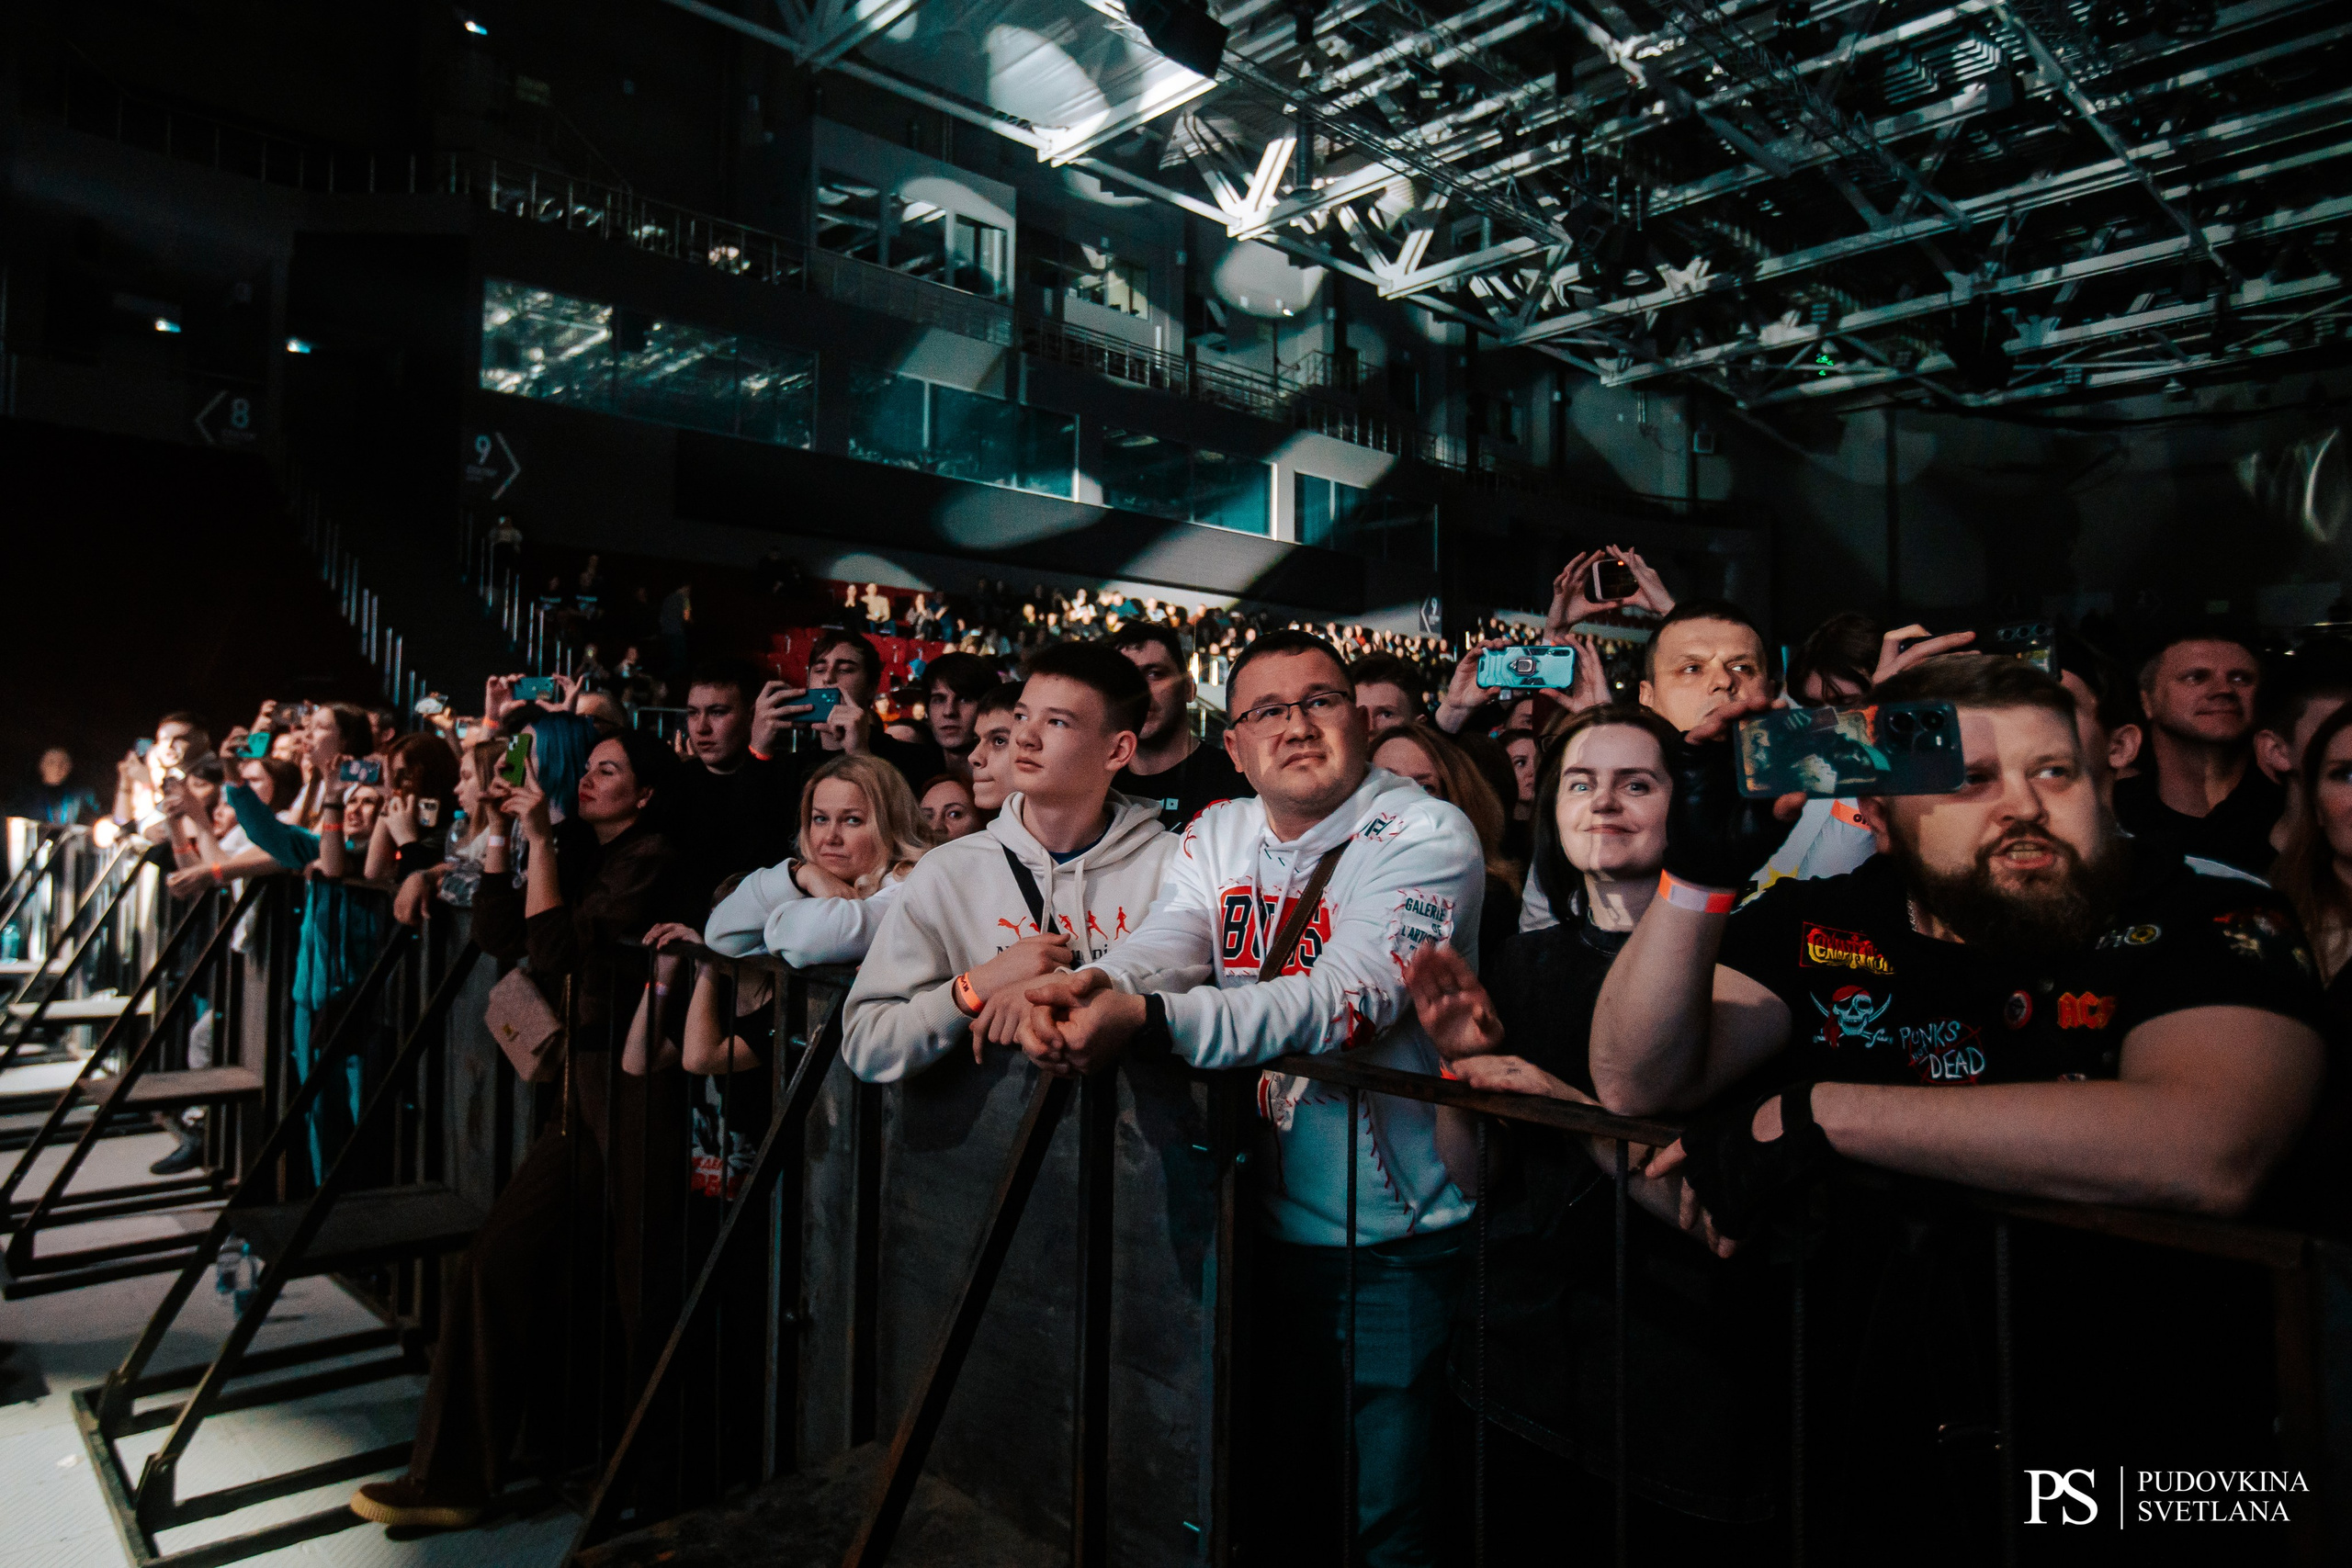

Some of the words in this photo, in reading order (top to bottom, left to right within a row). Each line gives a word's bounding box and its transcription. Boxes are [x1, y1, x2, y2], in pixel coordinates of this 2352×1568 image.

[232, 397, 249, 429] 8
[474, 434, 492, 465] 9
[1404, 897, 1446, 923] GALERIE
[1898, 1020, 1962, 1050] PUNKS
[1928, 1045, 1986, 1080] DEAD
